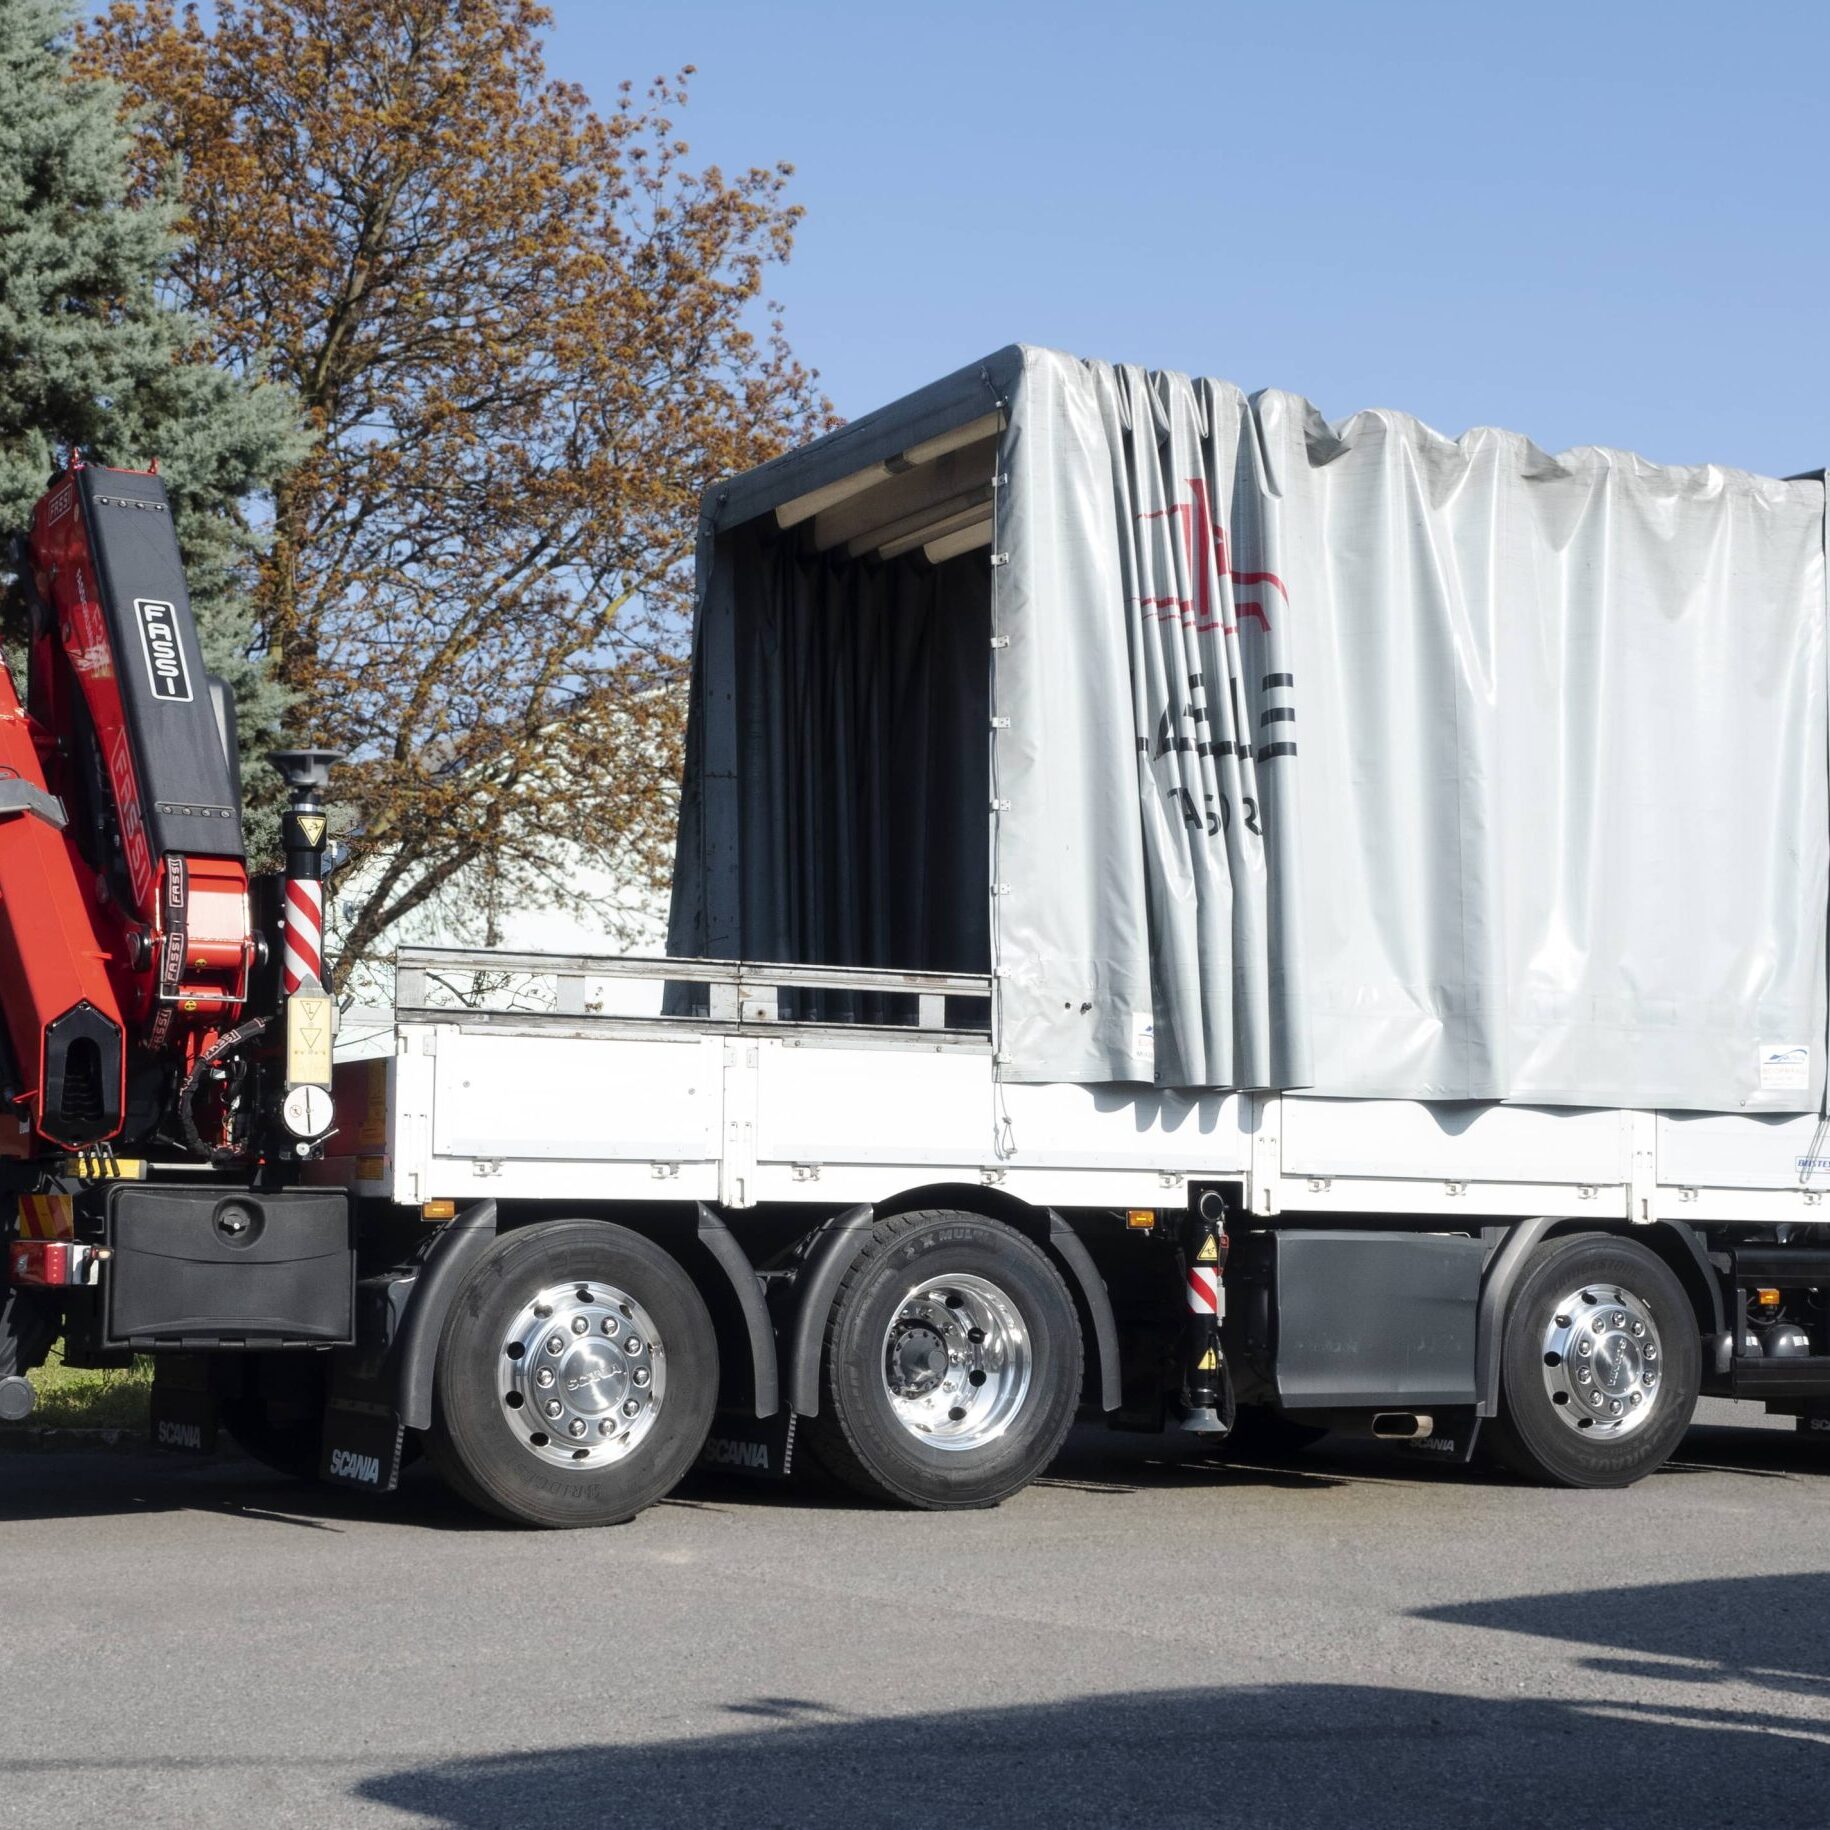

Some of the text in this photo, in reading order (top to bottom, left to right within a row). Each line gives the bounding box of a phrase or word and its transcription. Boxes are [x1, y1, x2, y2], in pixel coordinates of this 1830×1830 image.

[144, 604, 179, 695] FASSI
[115, 750, 147, 886] FASSI
[171, 860, 182, 903] FASSI
[167, 935, 181, 981] FASSI
[158, 1419, 201, 1449] SCANIA
[1810, 1418, 1830, 1431] SC
[331, 1449, 379, 1484] SCANIA
